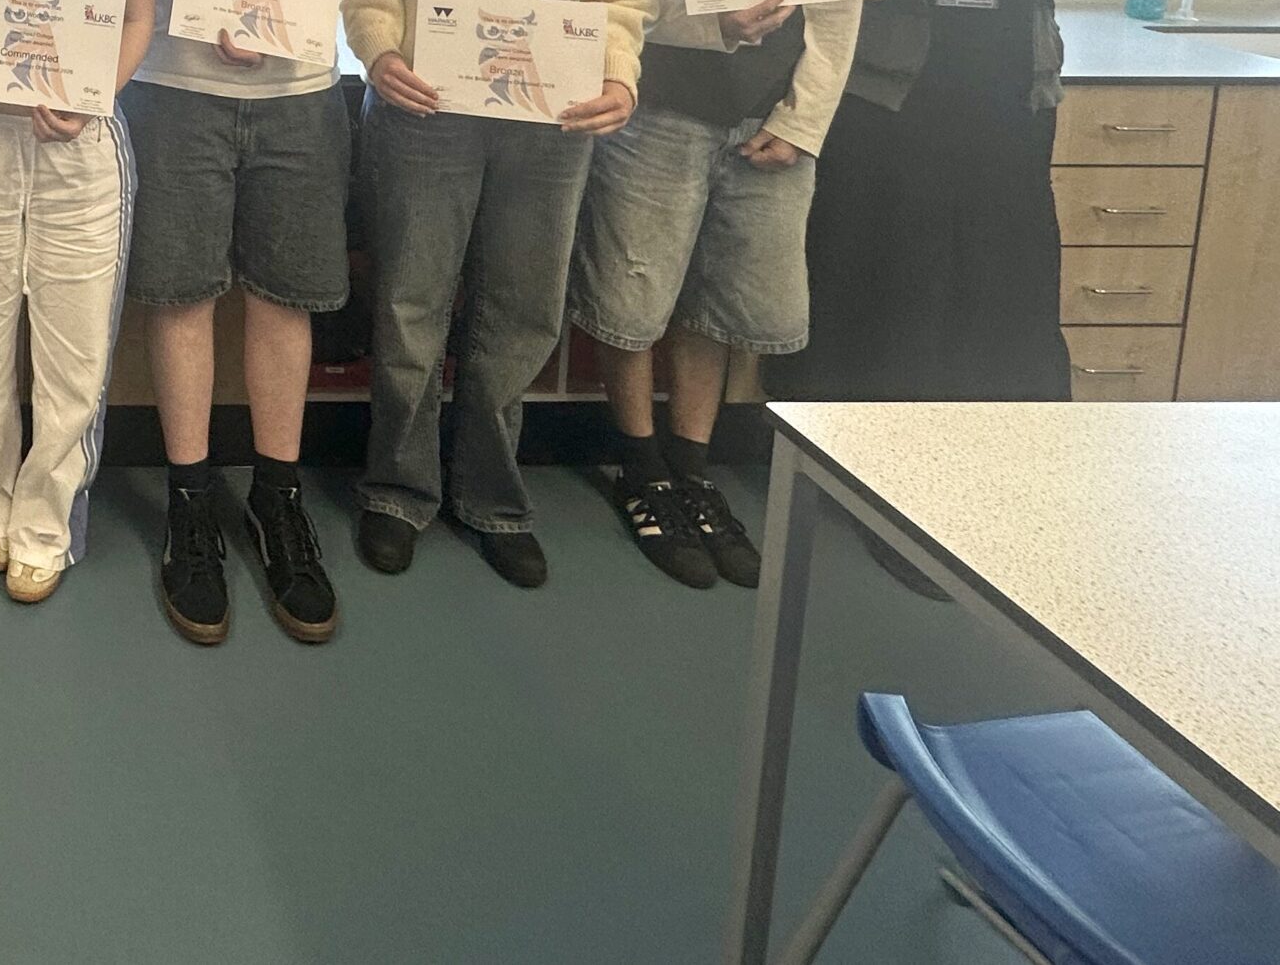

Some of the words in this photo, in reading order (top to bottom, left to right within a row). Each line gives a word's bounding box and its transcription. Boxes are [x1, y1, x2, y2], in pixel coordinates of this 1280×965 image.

[241, 0, 271, 13] Bronze
[0, 47, 59, 63] Commended
[489, 65, 524, 77] Bronze
